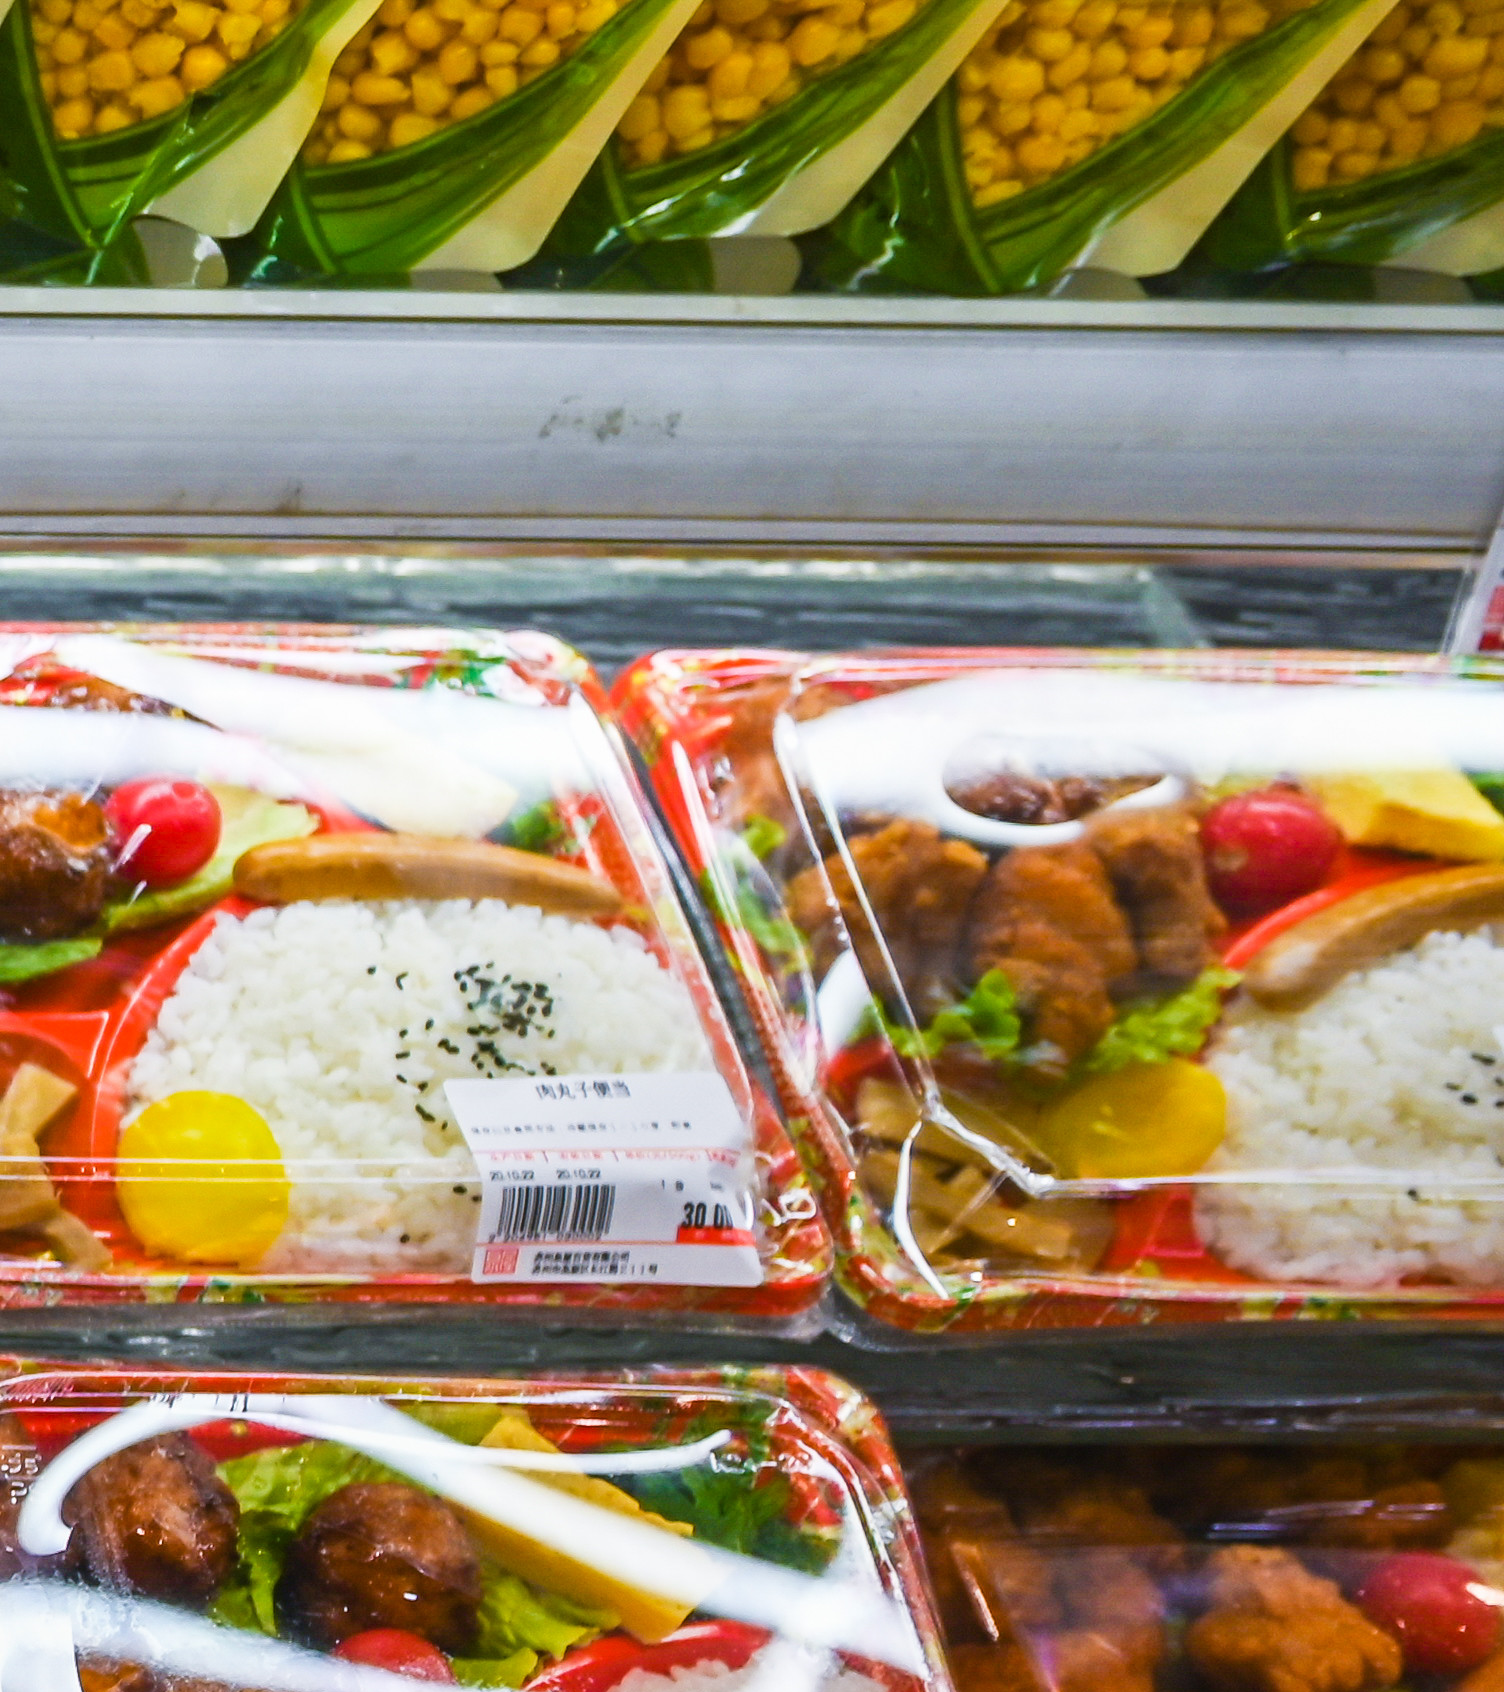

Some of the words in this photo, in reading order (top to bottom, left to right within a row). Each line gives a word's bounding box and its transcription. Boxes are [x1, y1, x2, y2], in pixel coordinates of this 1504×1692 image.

[536, 1080, 630, 1099] 肉丸子便当
